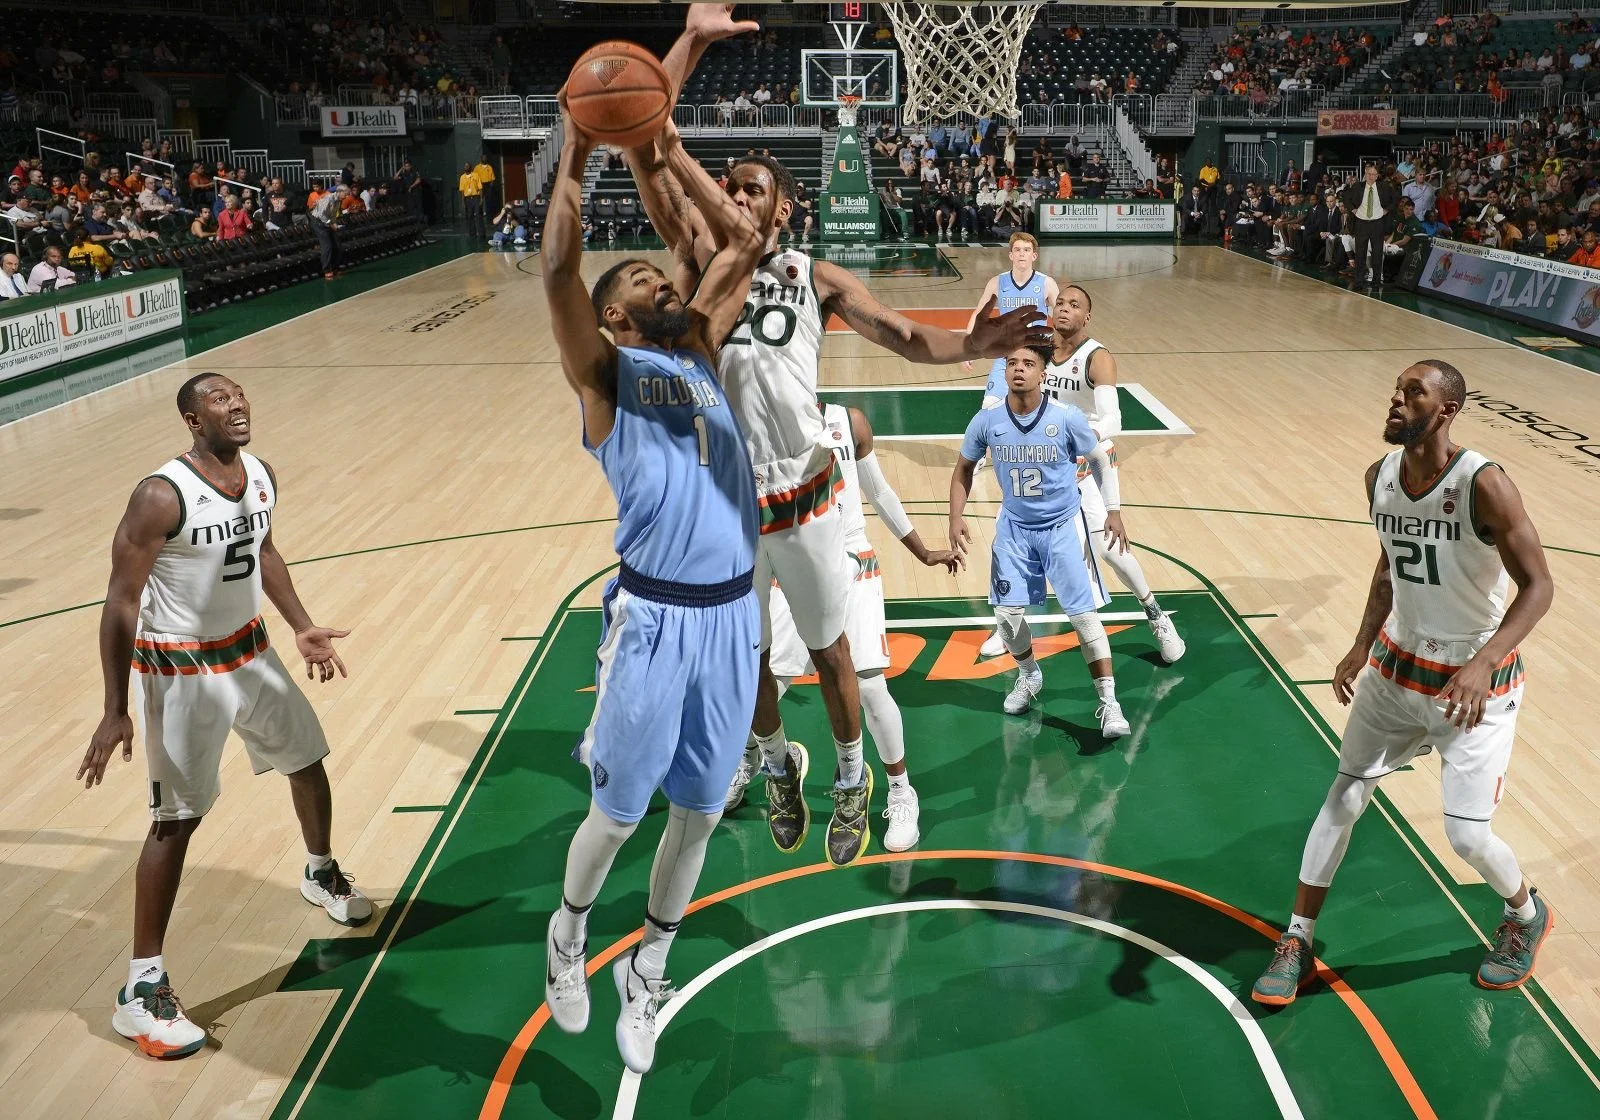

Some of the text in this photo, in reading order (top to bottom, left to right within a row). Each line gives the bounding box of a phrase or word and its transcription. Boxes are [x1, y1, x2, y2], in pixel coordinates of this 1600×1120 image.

[845, 2, 860, 18] 18
[331, 109, 397, 127] UHealth
[1050, 204, 1098, 216] UHealth
[1117, 204, 1165, 216] UHealth
[824, 222, 876, 230] WILLIAMSON
[1461, 246, 1483, 256] EASTERN
[1519, 258, 1546, 269] EASTERN
[1553, 266, 1581, 276] EASTERN
[1486, 270, 1562, 309] PLAY!
[126, 282, 179, 319] UHealth
[60, 297, 122, 337] UHealth
[638, 376, 720, 408] COLUBIA
[692, 413, 710, 467] 1
[995, 444, 1058, 464] COLUMBIA
[1009, 467, 1044, 498] 12
[222, 537, 256, 582] 5
[1391, 539, 1441, 586] 21
